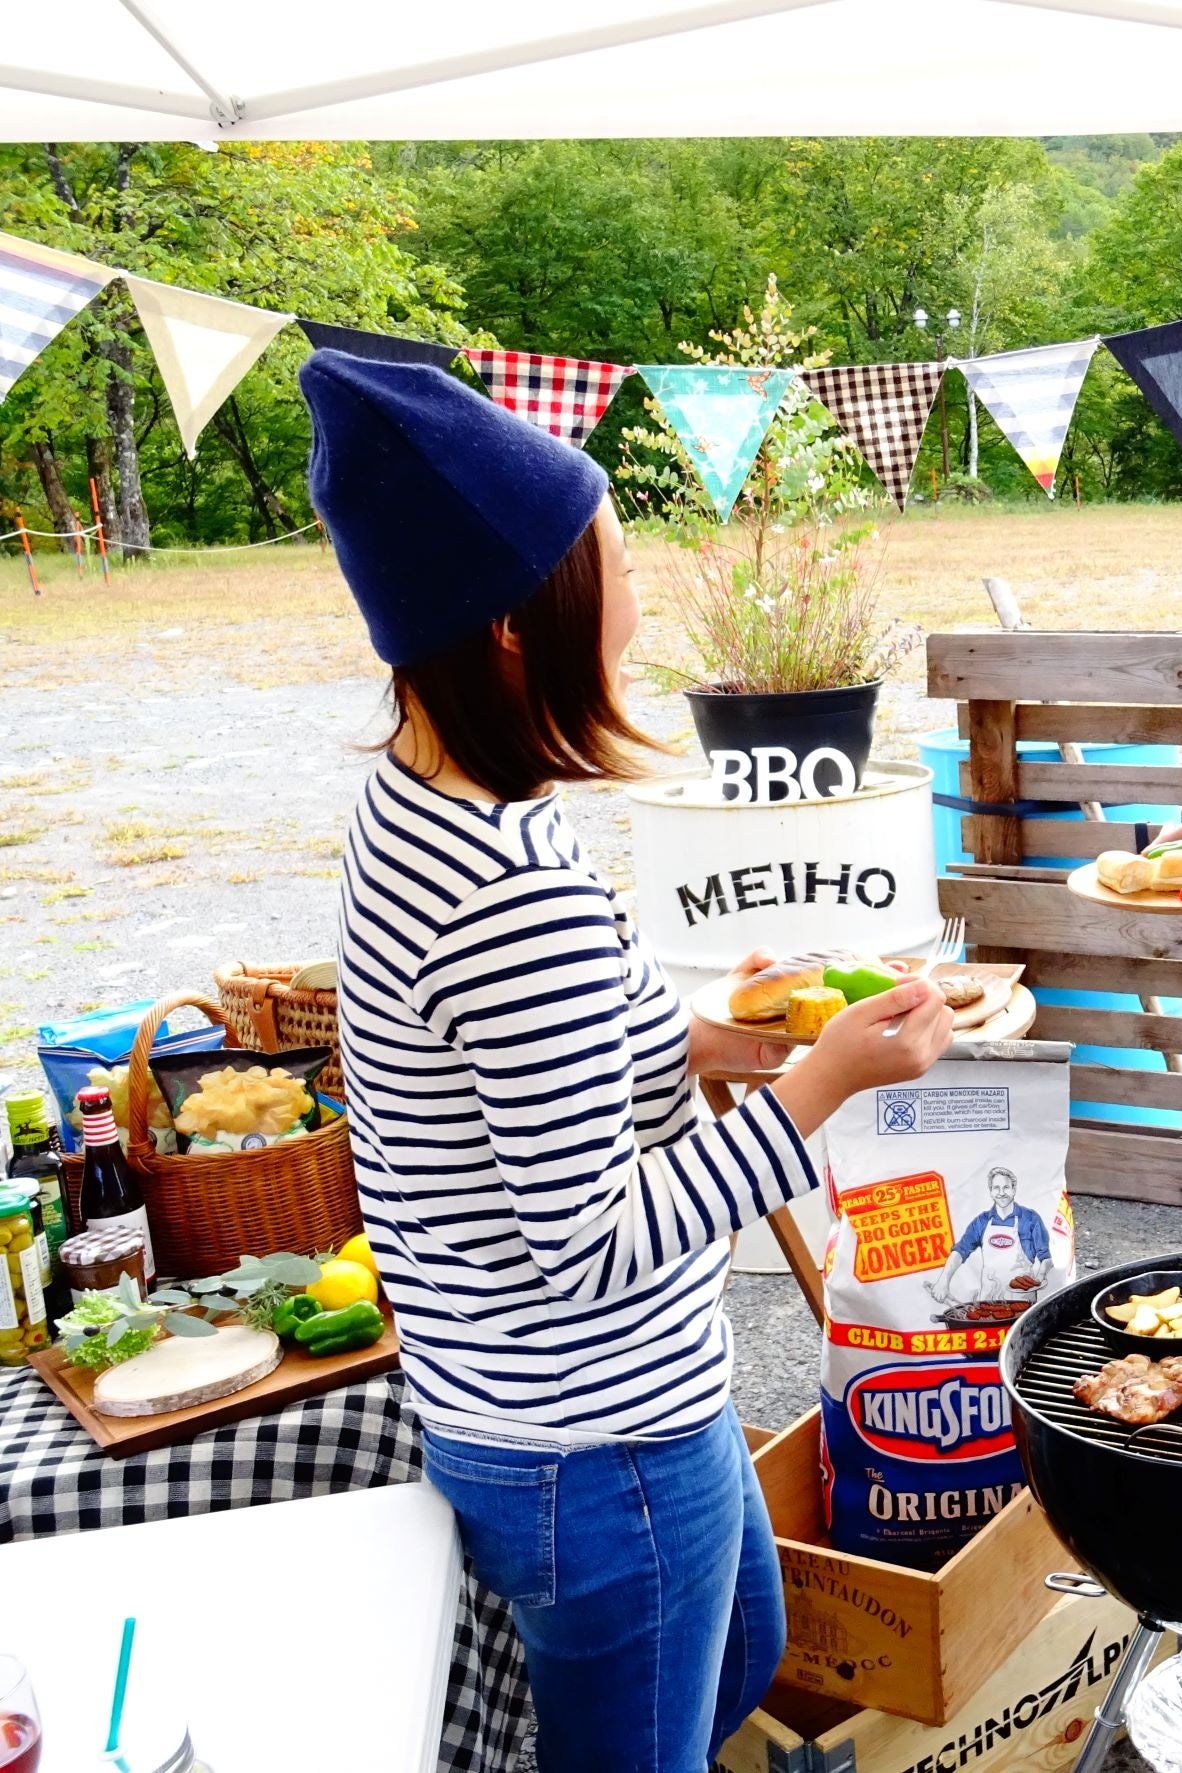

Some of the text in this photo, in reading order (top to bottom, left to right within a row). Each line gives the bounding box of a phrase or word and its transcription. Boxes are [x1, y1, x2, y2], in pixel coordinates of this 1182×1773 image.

[709, 747, 856, 802] BBQ
[676, 862, 897, 927] MEIHO
[886, 1091, 920, 1099] WARNING
[903, 1181, 940, 1196] FASTER
[905, 1202, 940, 1218] THE
[888, 1214, 943, 1238] GOING
[848, 1327, 904, 1350] CLUB
[911, 1332, 967, 1352] SIZE
[865, 1467, 884, 1480] The
[902, 1626, 1129, 1773] ECHNOALP
